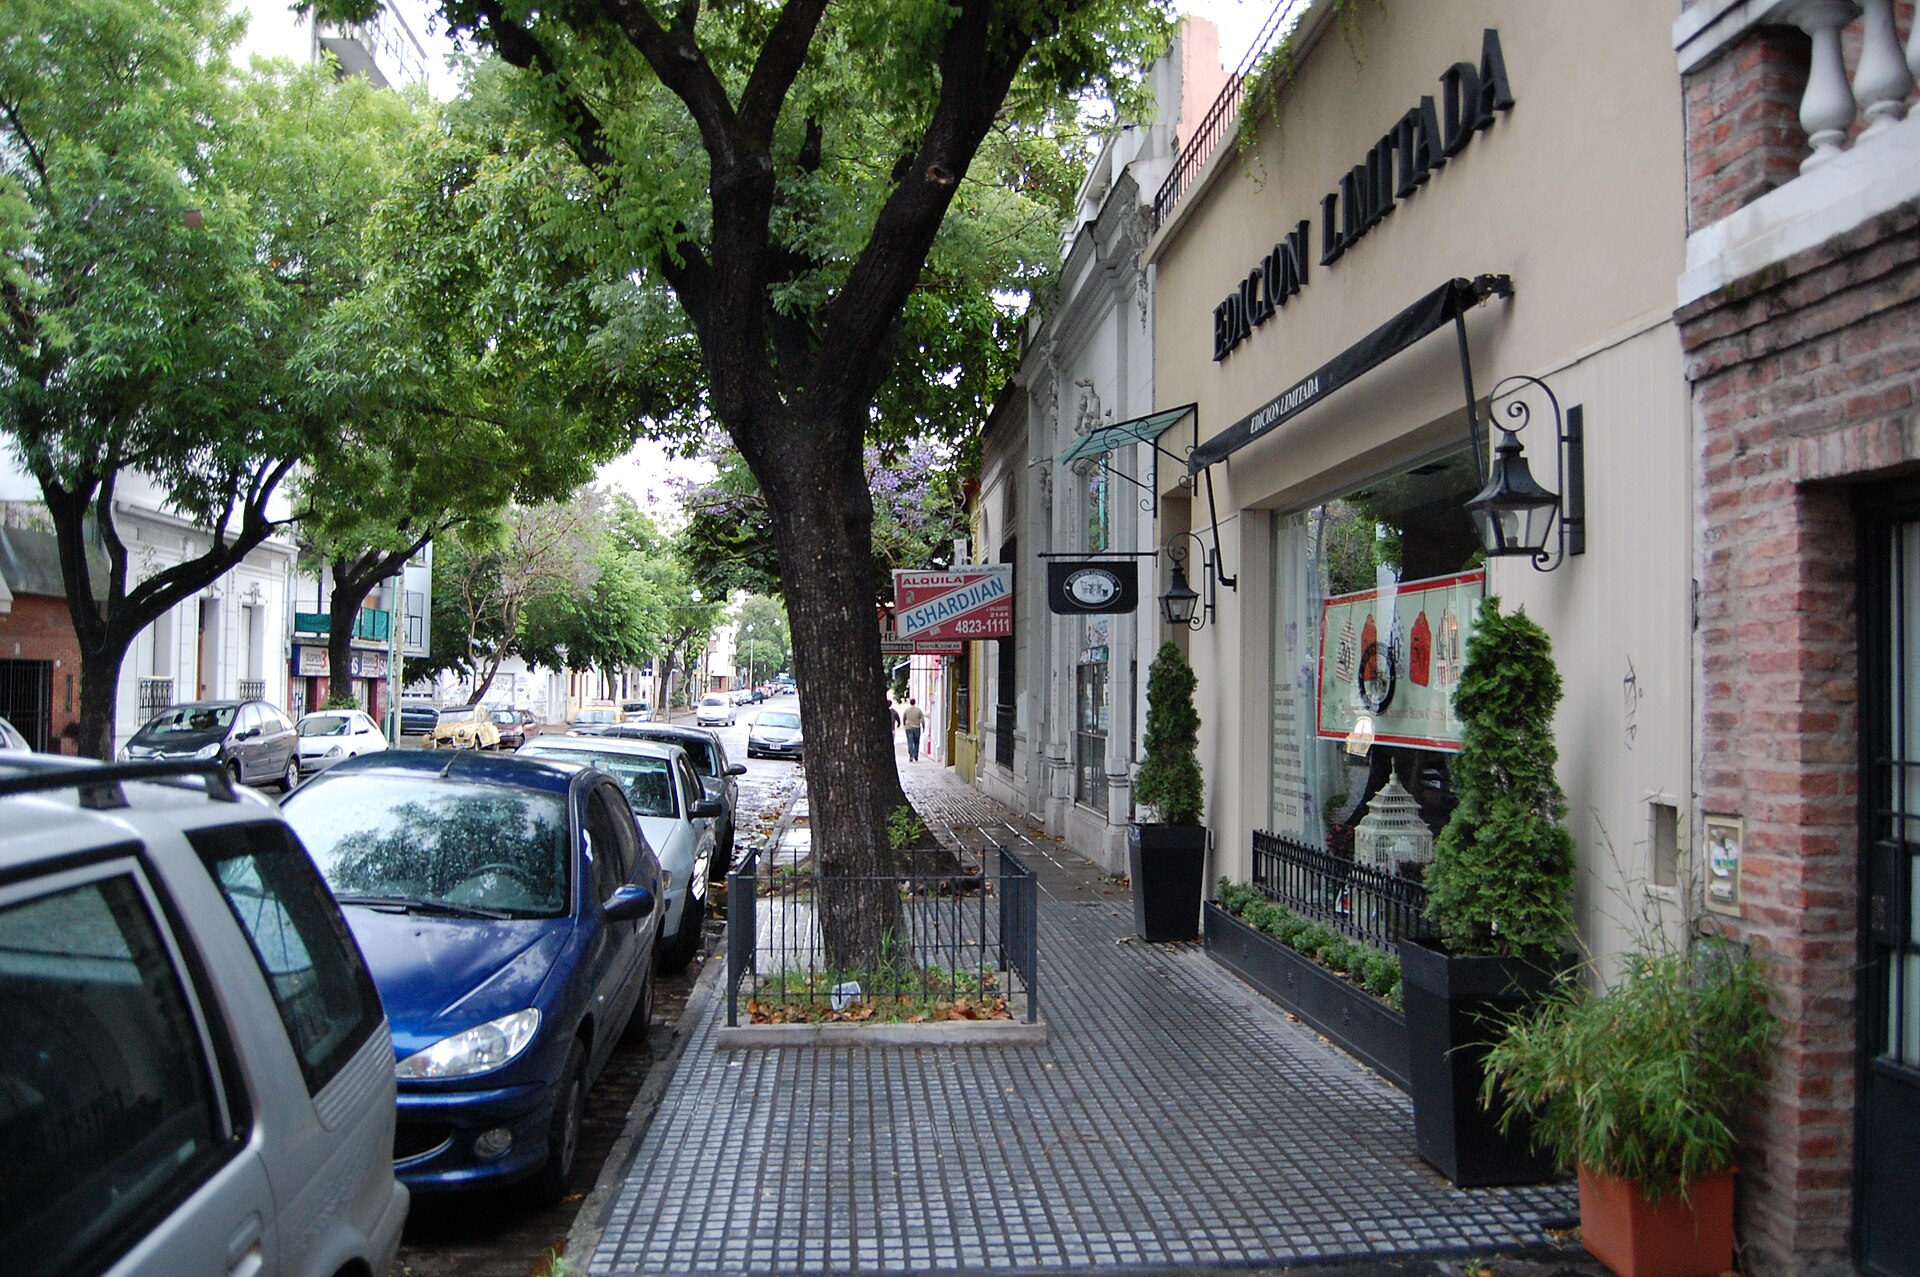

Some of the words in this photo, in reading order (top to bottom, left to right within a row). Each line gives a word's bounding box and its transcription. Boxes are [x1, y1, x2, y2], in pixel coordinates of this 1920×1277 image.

[1212, 219, 1310, 363] EDICION
[1319, 28, 1515, 267] LIMITADA
[1250, 400, 1280, 434] EDICION
[1280, 375, 1319, 415] LIMITADA
[903, 576, 963, 586] ALQUILA
[906, 576, 1005, 633] ASHARDJIAN
[955, 618, 1010, 634] 4823-1111
